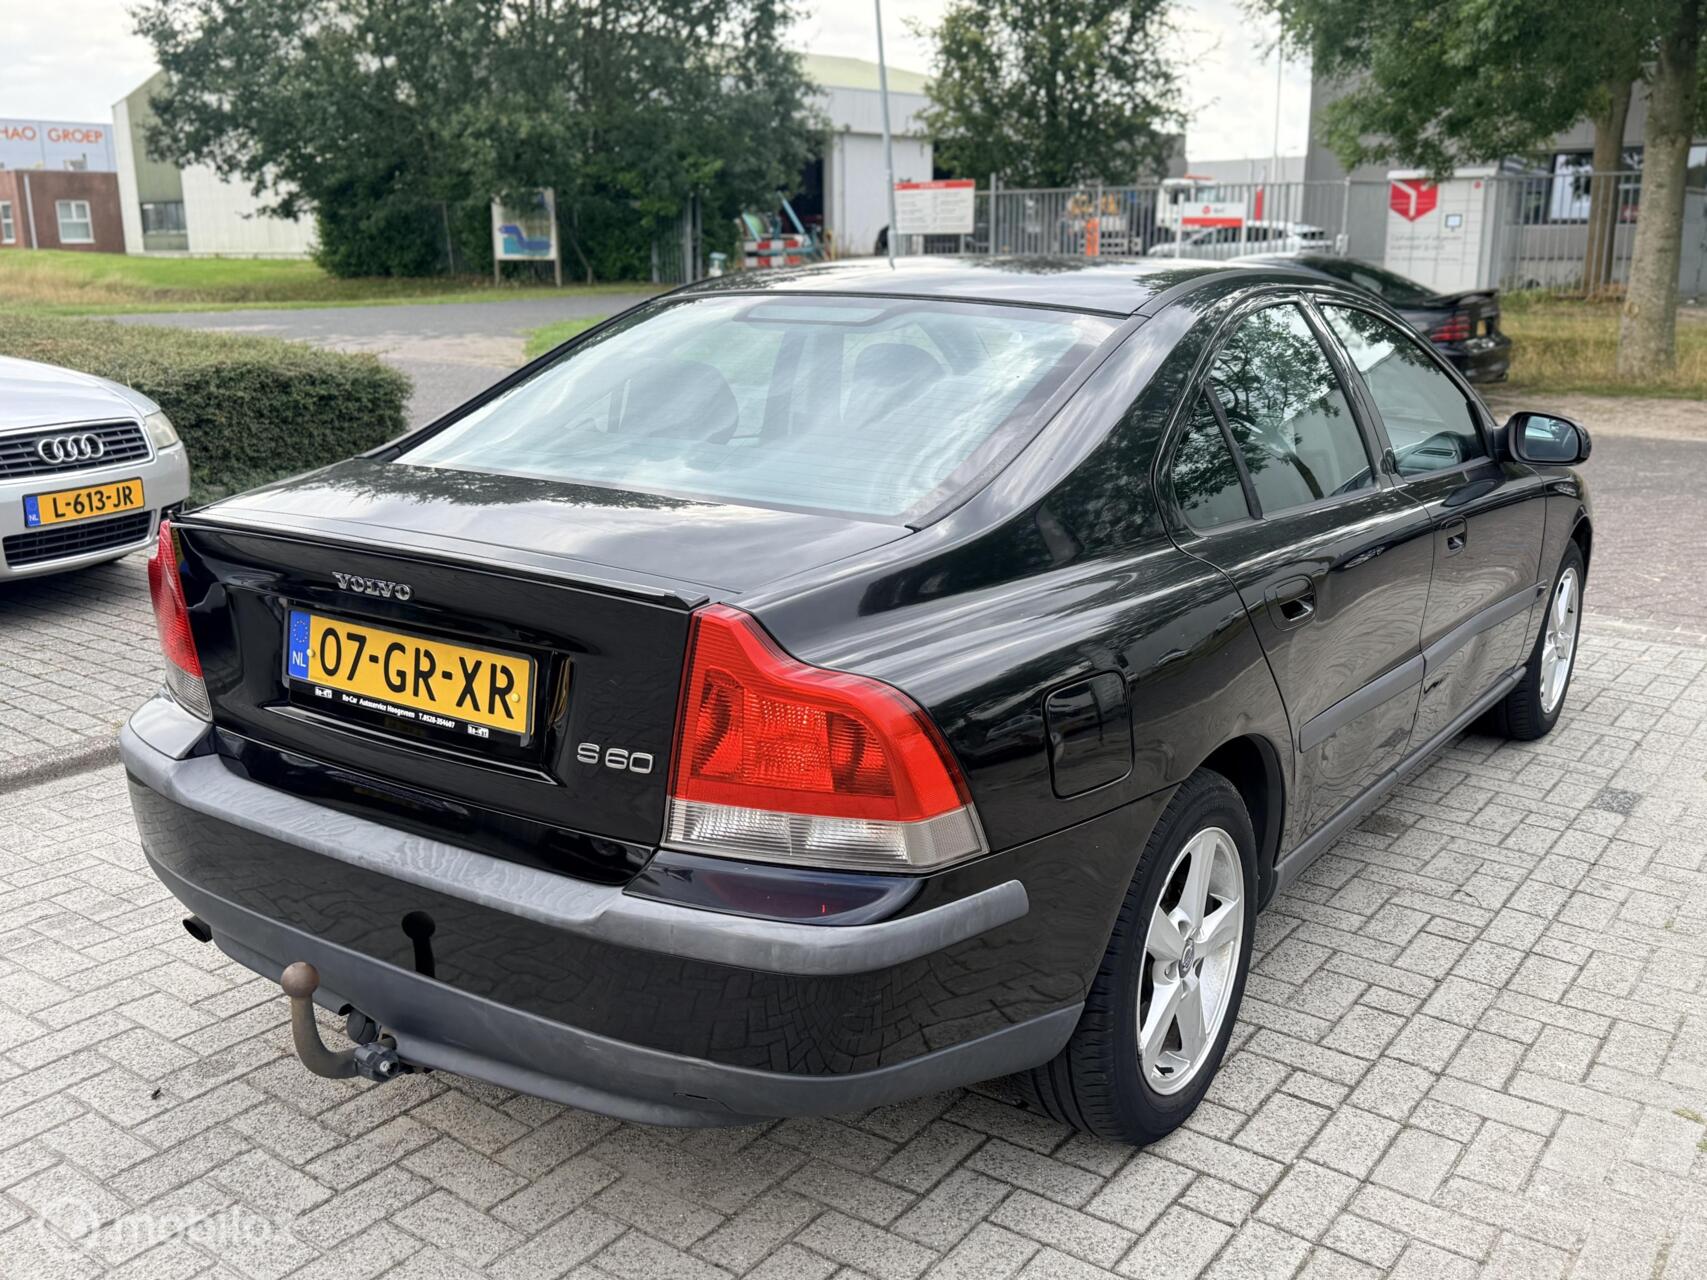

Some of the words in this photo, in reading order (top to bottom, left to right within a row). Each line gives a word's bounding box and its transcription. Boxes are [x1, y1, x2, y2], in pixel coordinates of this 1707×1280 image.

[48, 127, 103, 144] GROEP
[52, 485, 135, 519] L-613-JR
[29, 514, 39, 522] NL
[332, 571, 413, 601] VOLVO
[292, 650, 307, 668] NL
[319, 627, 515, 719] 07-GR-XR
